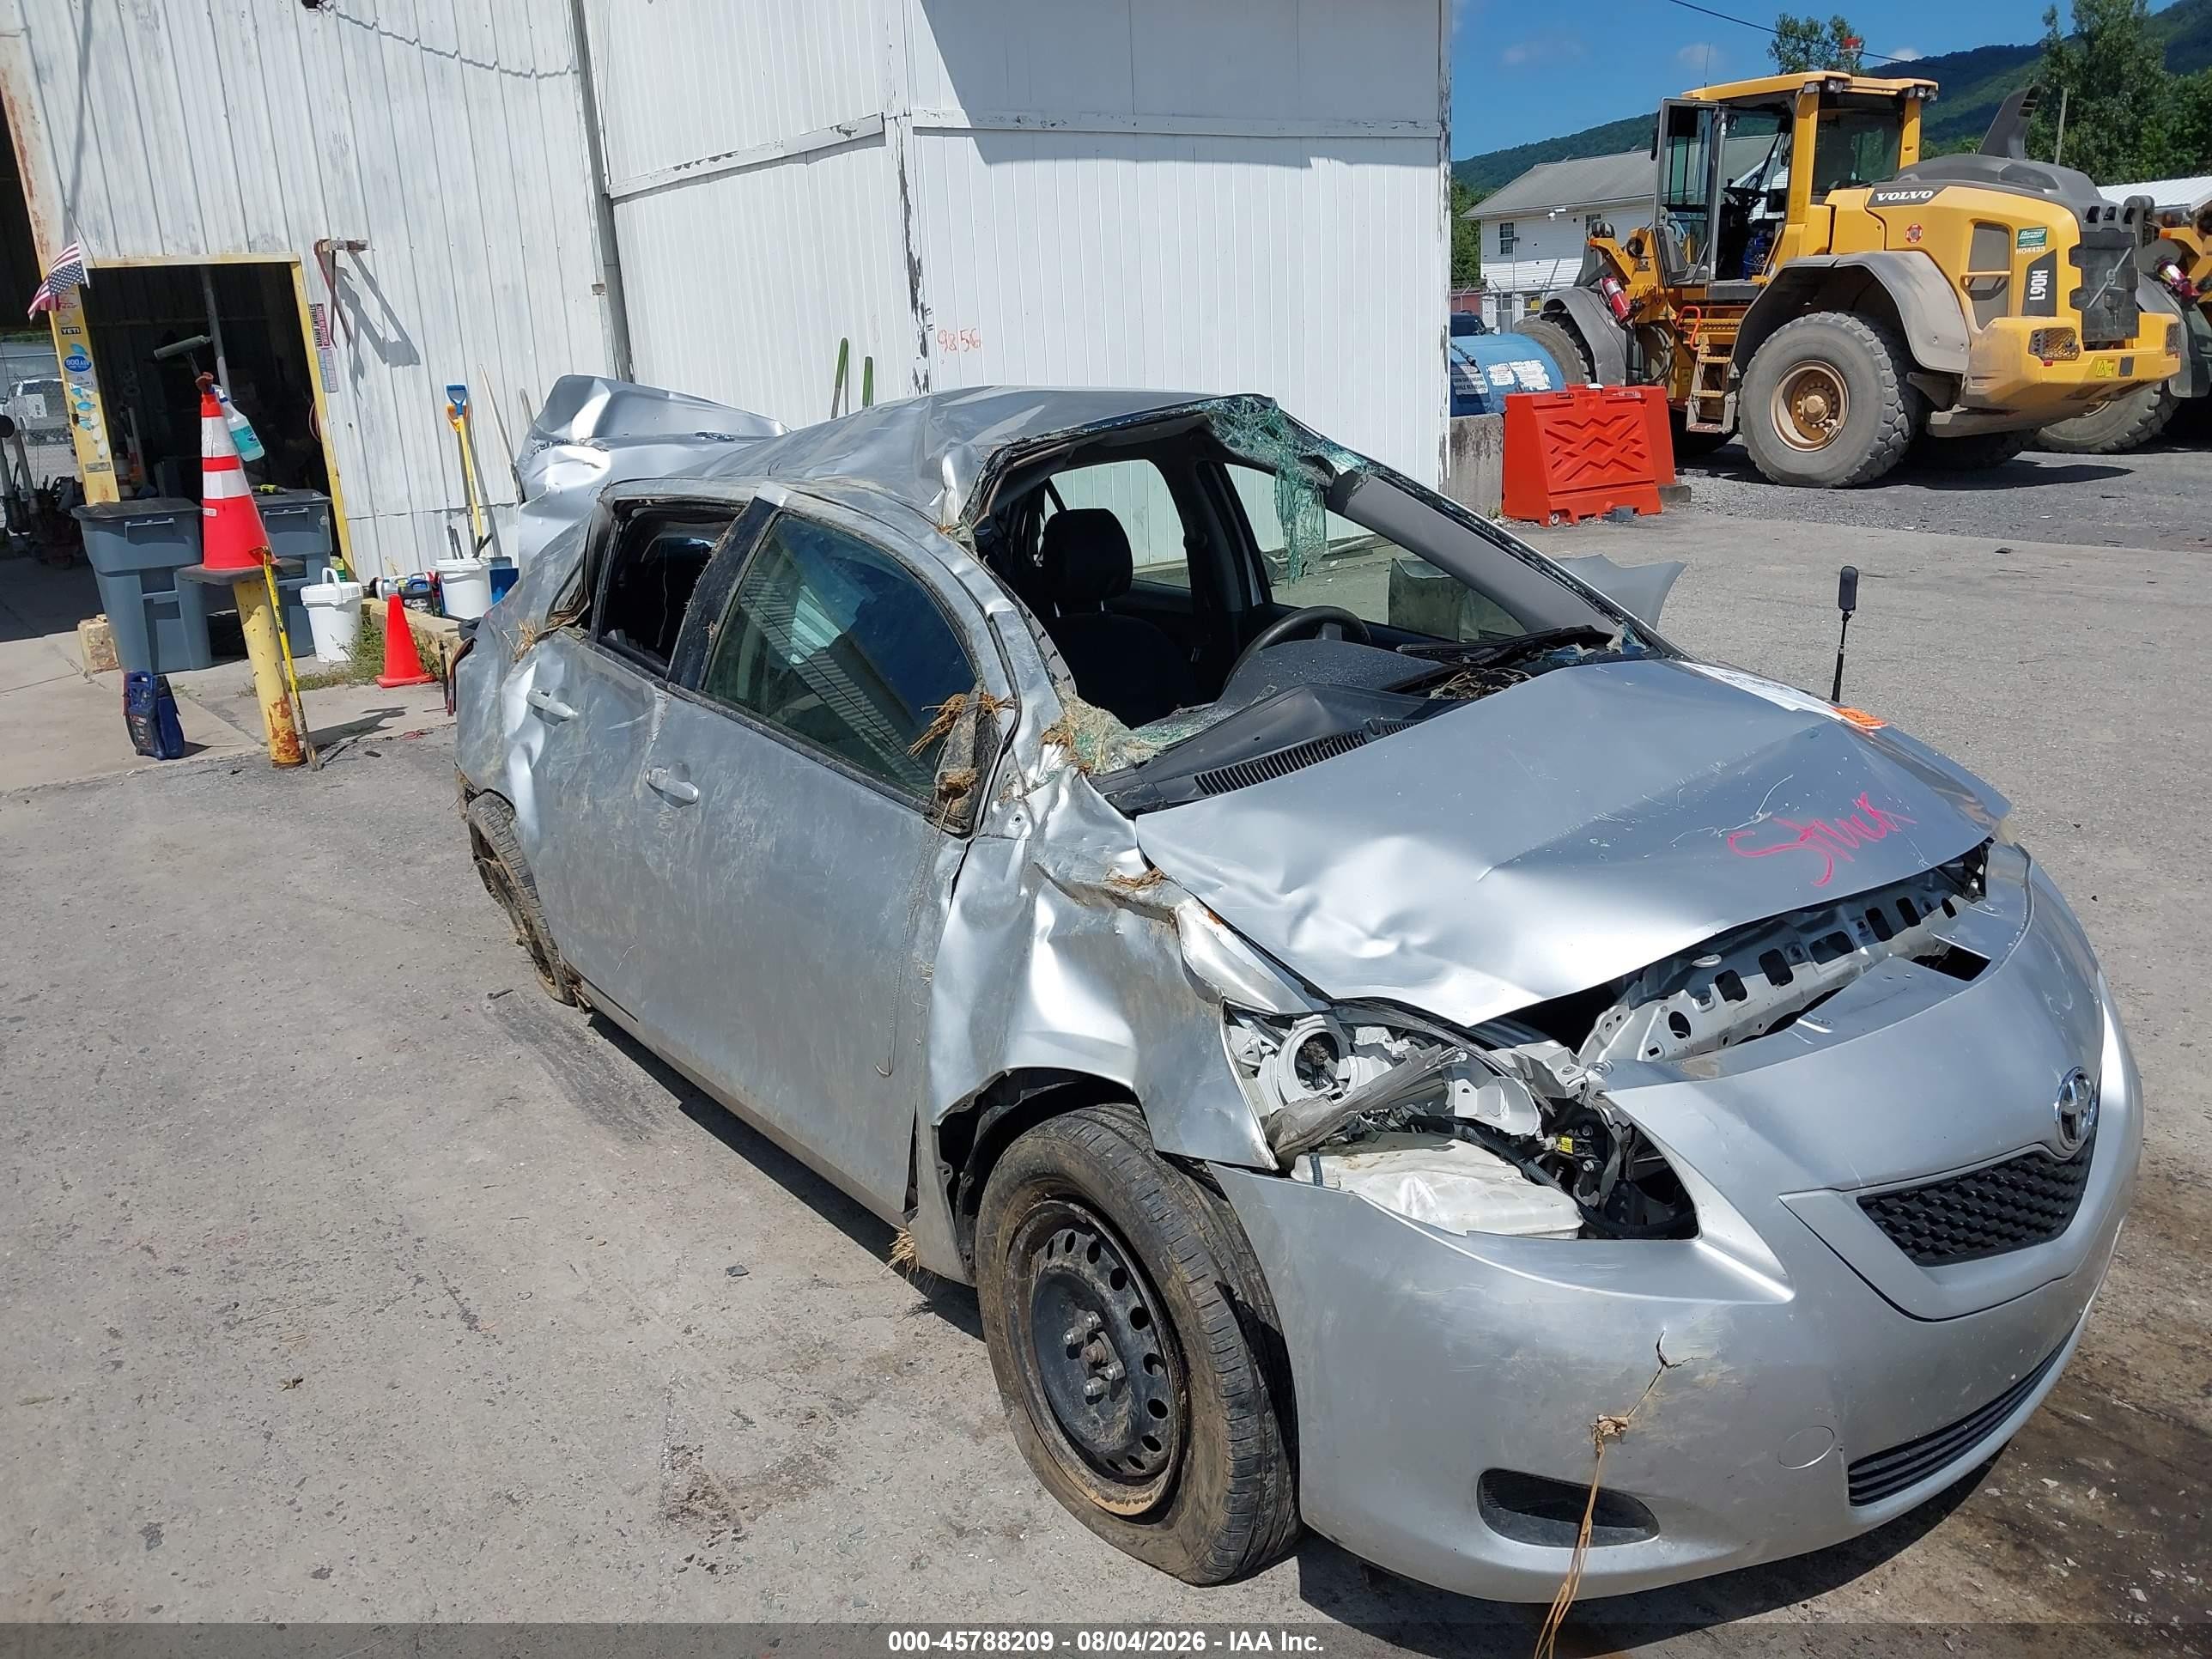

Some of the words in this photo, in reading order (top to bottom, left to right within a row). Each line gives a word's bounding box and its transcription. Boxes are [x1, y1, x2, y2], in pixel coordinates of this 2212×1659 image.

[1876, 191, 1934, 201] VOLVO
[2029, 270, 2049, 301] L90H
[309, 304, 319, 328] STUDENT
[937, 329, 981, 352] 9856
